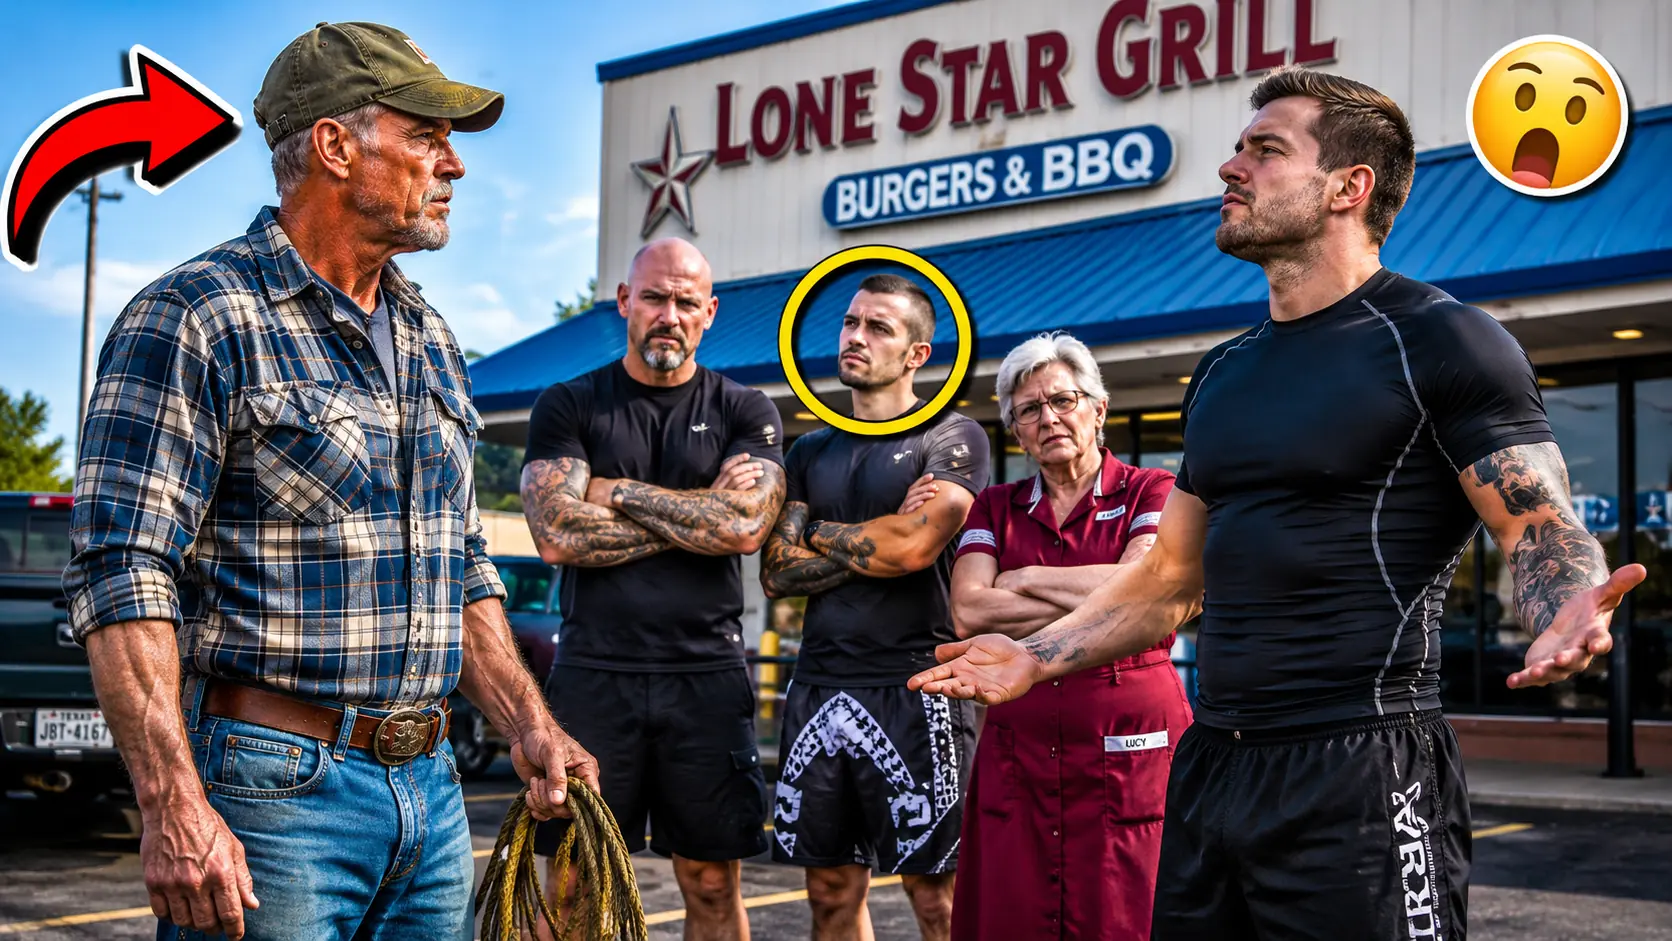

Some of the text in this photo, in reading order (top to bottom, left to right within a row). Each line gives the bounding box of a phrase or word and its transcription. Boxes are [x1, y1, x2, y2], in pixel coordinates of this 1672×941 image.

[715, 0, 1338, 168] LONE STAR GRILL
[835, 131, 1155, 223] BURGERS & BBQ
[1125, 738, 1147, 748] LUCY
